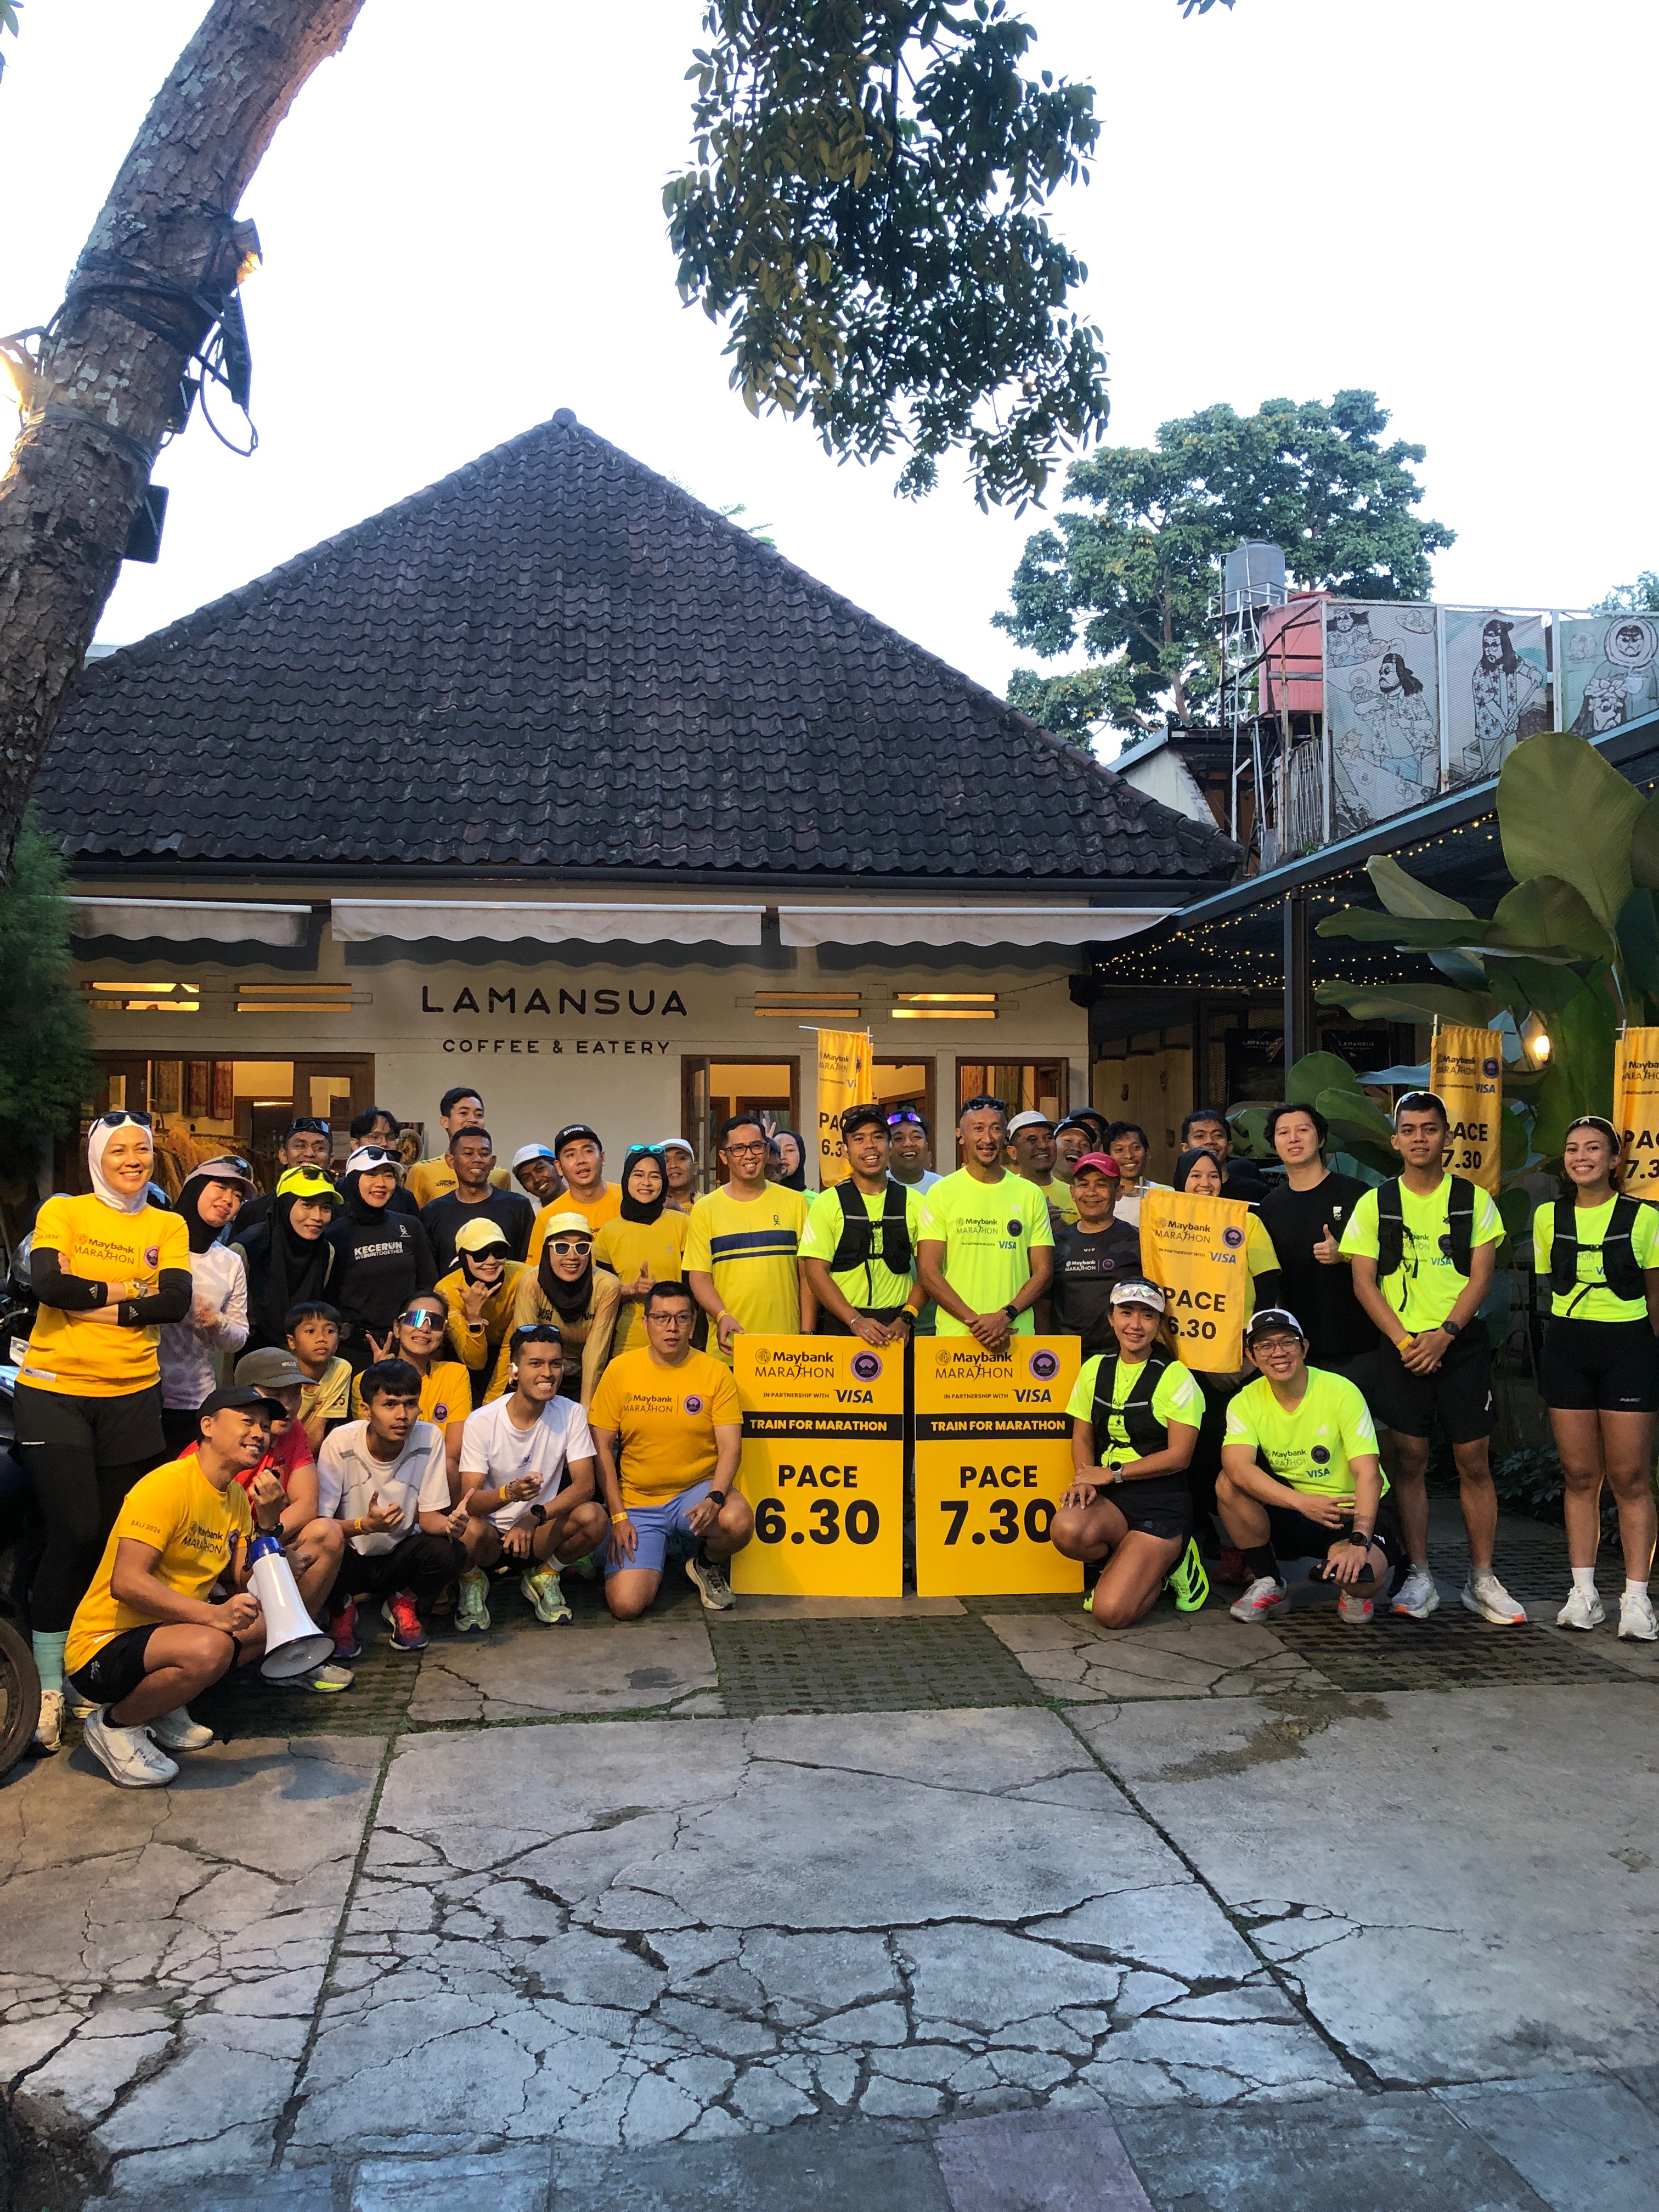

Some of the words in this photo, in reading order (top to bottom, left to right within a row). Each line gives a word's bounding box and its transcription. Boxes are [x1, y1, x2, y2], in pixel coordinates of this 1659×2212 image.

[422, 985, 687, 1016] LAMANSUA
[442, 1039, 539, 1054] COFFEE
[552, 1040, 563, 1053] &
[576, 1041, 670, 1054] EATERY
[823, 1053, 849, 1063] Maybnk
[1443, 1055, 1476, 1065] Maybank
[1475, 1082, 1496, 1094] VISA
[1442, 1149, 1482, 1170] 7.30
[957, 1225, 998, 1234] MARATHON
[1167, 1220, 1211, 1233] Maybank
[1155, 1229, 1211, 1244] MARATHON
[88, 1238, 134, 1254] Maybank
[354, 1242, 403, 1256] KECERUN
[997, 1240, 1017, 1250] VISA
[74, 1245, 134, 1265] MARATHON
[1164, 1248, 1193, 1256] PARTNERSHIP
[1209, 1251, 1237, 1264] VISA
[1430, 1256, 1452, 1266] VISA
[1163, 1286, 1227, 1313] PACE
[1167, 1316, 1216, 1340] 6.30
[772, 1351, 834, 1364] Maybank
[953, 1352, 1013, 1365] Maybank
[754, 1363, 835, 1381] MARATHON
[935, 1363, 1013, 1382] MARATHON
[633, 1395, 673, 1403] Maybank
[833, 1389, 874, 1403] VISA
[1012, 1389, 1052, 1402] VISA
[623, 1403, 673, 1414] MARATHON
[749, 1419, 787, 1430] TRAIN
[789, 1419, 813, 1430] FOR
[815, 1420, 887, 1431] MARATHON
[930, 1421, 967, 1431] TRAIN
[969, 1421, 993, 1431] FOR
[995, 1420, 1065, 1431] MARATHON
[1272, 1449, 1307, 1459] Maybank
[778, 1464, 858, 1488] PACE
[960, 1465, 1038, 1488] PACE
[1306, 1468, 1330, 1478] VISA
[131, 1520, 144, 1528] BALI
[145, 1524, 161, 1534] 2024
[755, 1498, 880, 1545] 6.30
[940, 1498, 1054, 1545] 7.30
[180, 1536, 223, 1555] MARATHON
